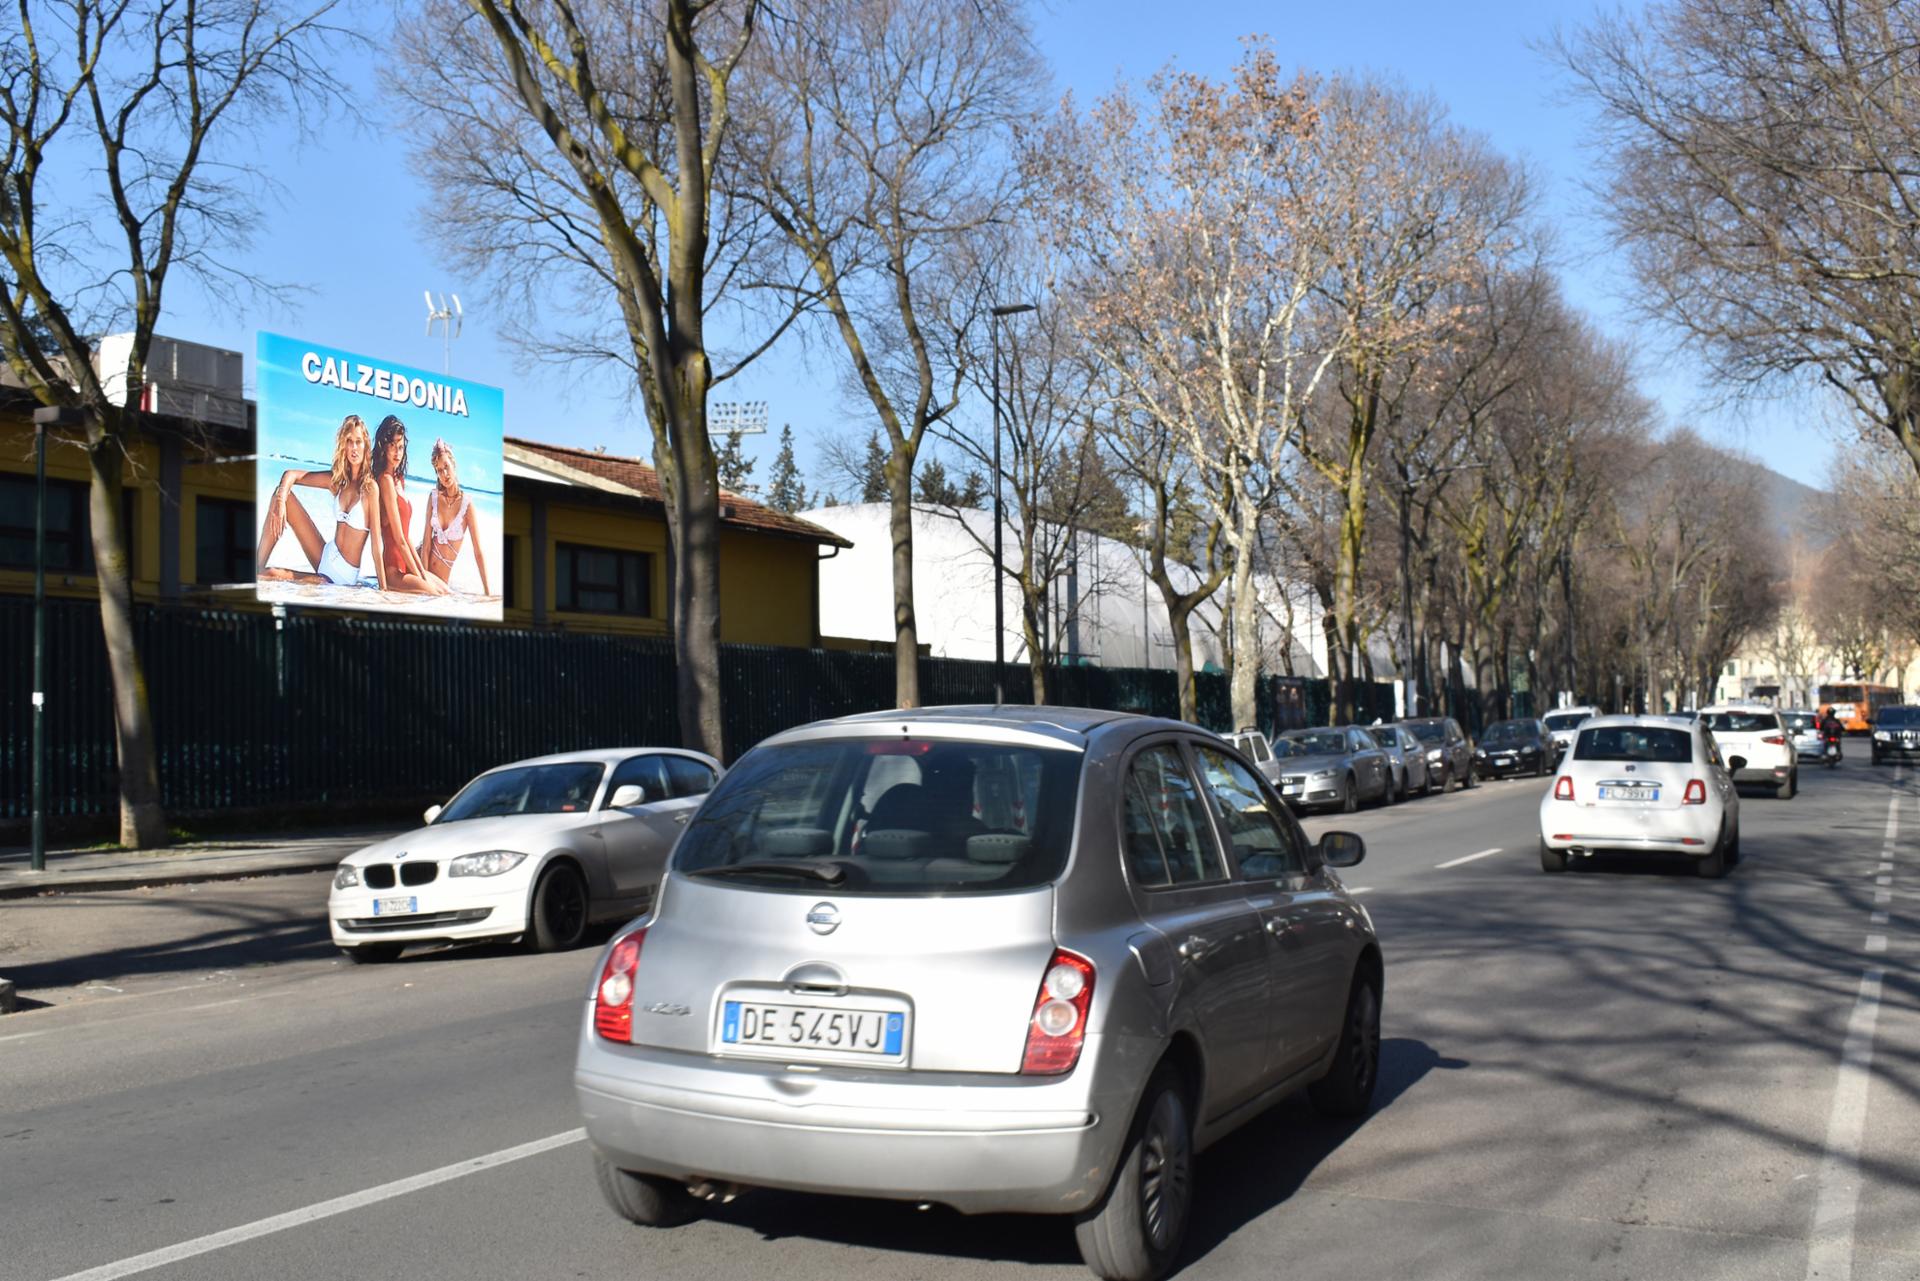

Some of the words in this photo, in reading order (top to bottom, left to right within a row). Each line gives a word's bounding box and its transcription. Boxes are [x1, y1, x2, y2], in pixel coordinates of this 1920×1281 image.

[301, 352, 469, 417] CALZEDONIA
[742, 1007, 777, 1041] DE
[788, 1010, 883, 1049] 545VJ
